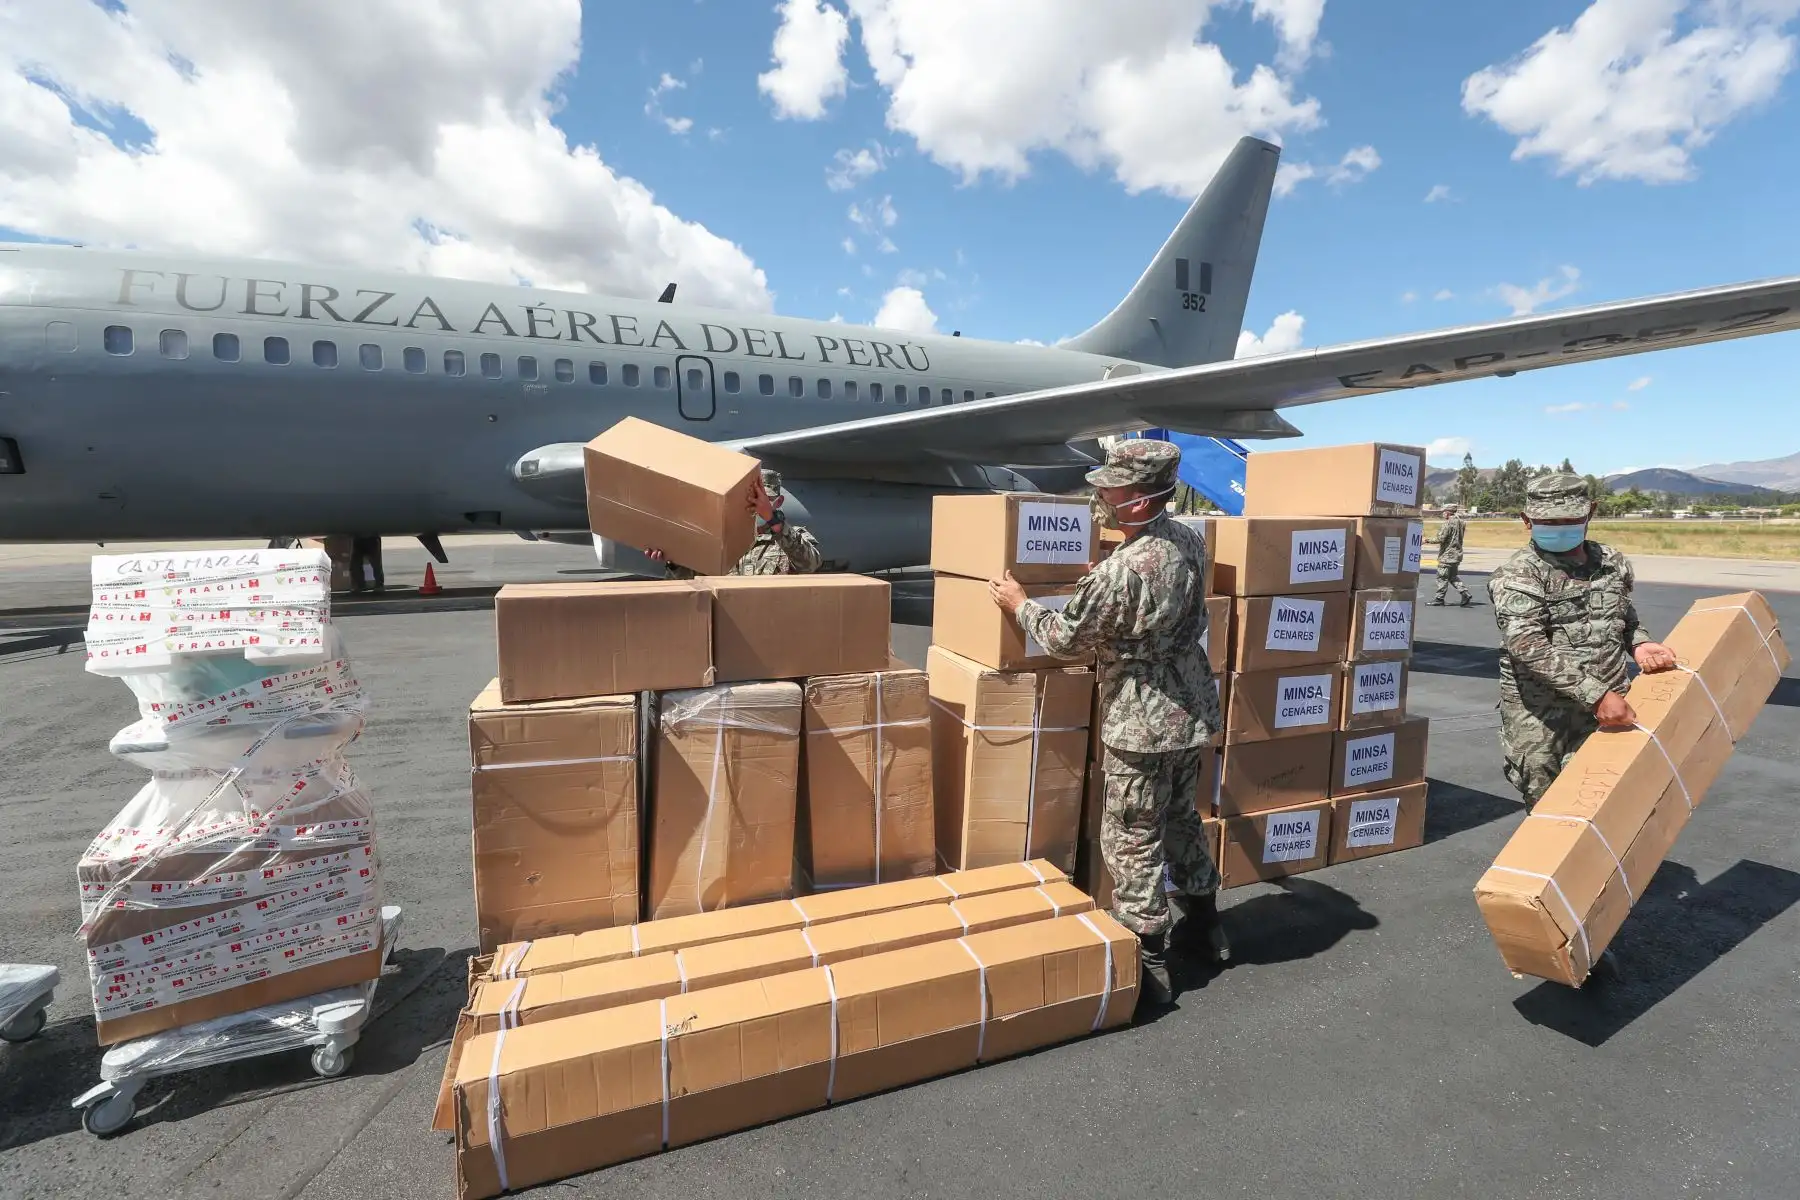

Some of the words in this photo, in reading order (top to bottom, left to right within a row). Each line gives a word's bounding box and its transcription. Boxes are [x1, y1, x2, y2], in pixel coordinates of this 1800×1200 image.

[1182, 292, 1206, 313] 352
[116, 268, 457, 332] FUERZA
[471, 301, 688, 350] AÉREA
[700, 322, 806, 361] DEL
[813, 334, 931, 372] PERÚ
[1385, 461, 1413, 477] MINSA
[1383, 482, 1412, 494] CENARES
[1029, 516, 1080, 532] MINSA
[1027, 540, 1081, 551] CENARES
[1299, 541, 1337, 555] MINSA
[1297, 561, 1338, 572] CENARES
[177, 583, 246, 595] FRAGIL
[1277, 609, 1314, 624] MINSA
[1371, 612, 1404, 623] MINSA
[1274, 630, 1313, 640] CENARES
[1370, 631, 1405, 641] CENARES
[178, 639, 248, 650] FRAGIL
[1361, 673, 1393, 687] MINSA
[1284, 686, 1322, 700] MINSA
[1359, 691, 1394, 703] CENARES
[178, 690, 237, 718] FRAGIL
[1282, 705, 1323, 717] CENARES
[1353, 744, 1387, 761] MINSA
[1351, 762, 1387, 776] CENARES
[1356, 809, 1389, 824] MINSA
[1273, 822, 1311, 836] MINSA
[1353, 827, 1390, 838] CENARES
[1270, 840, 1310, 852] CENARES
[276, 856, 340, 874] FRAGIL
[272, 879, 334, 904] FRAGIL
[156, 912, 228, 938] FRAGIL
[244, 925, 310, 946] FRAGIL
[128, 954, 200, 978] FRAGIL
[186, 960, 256, 982] FRAGIL
